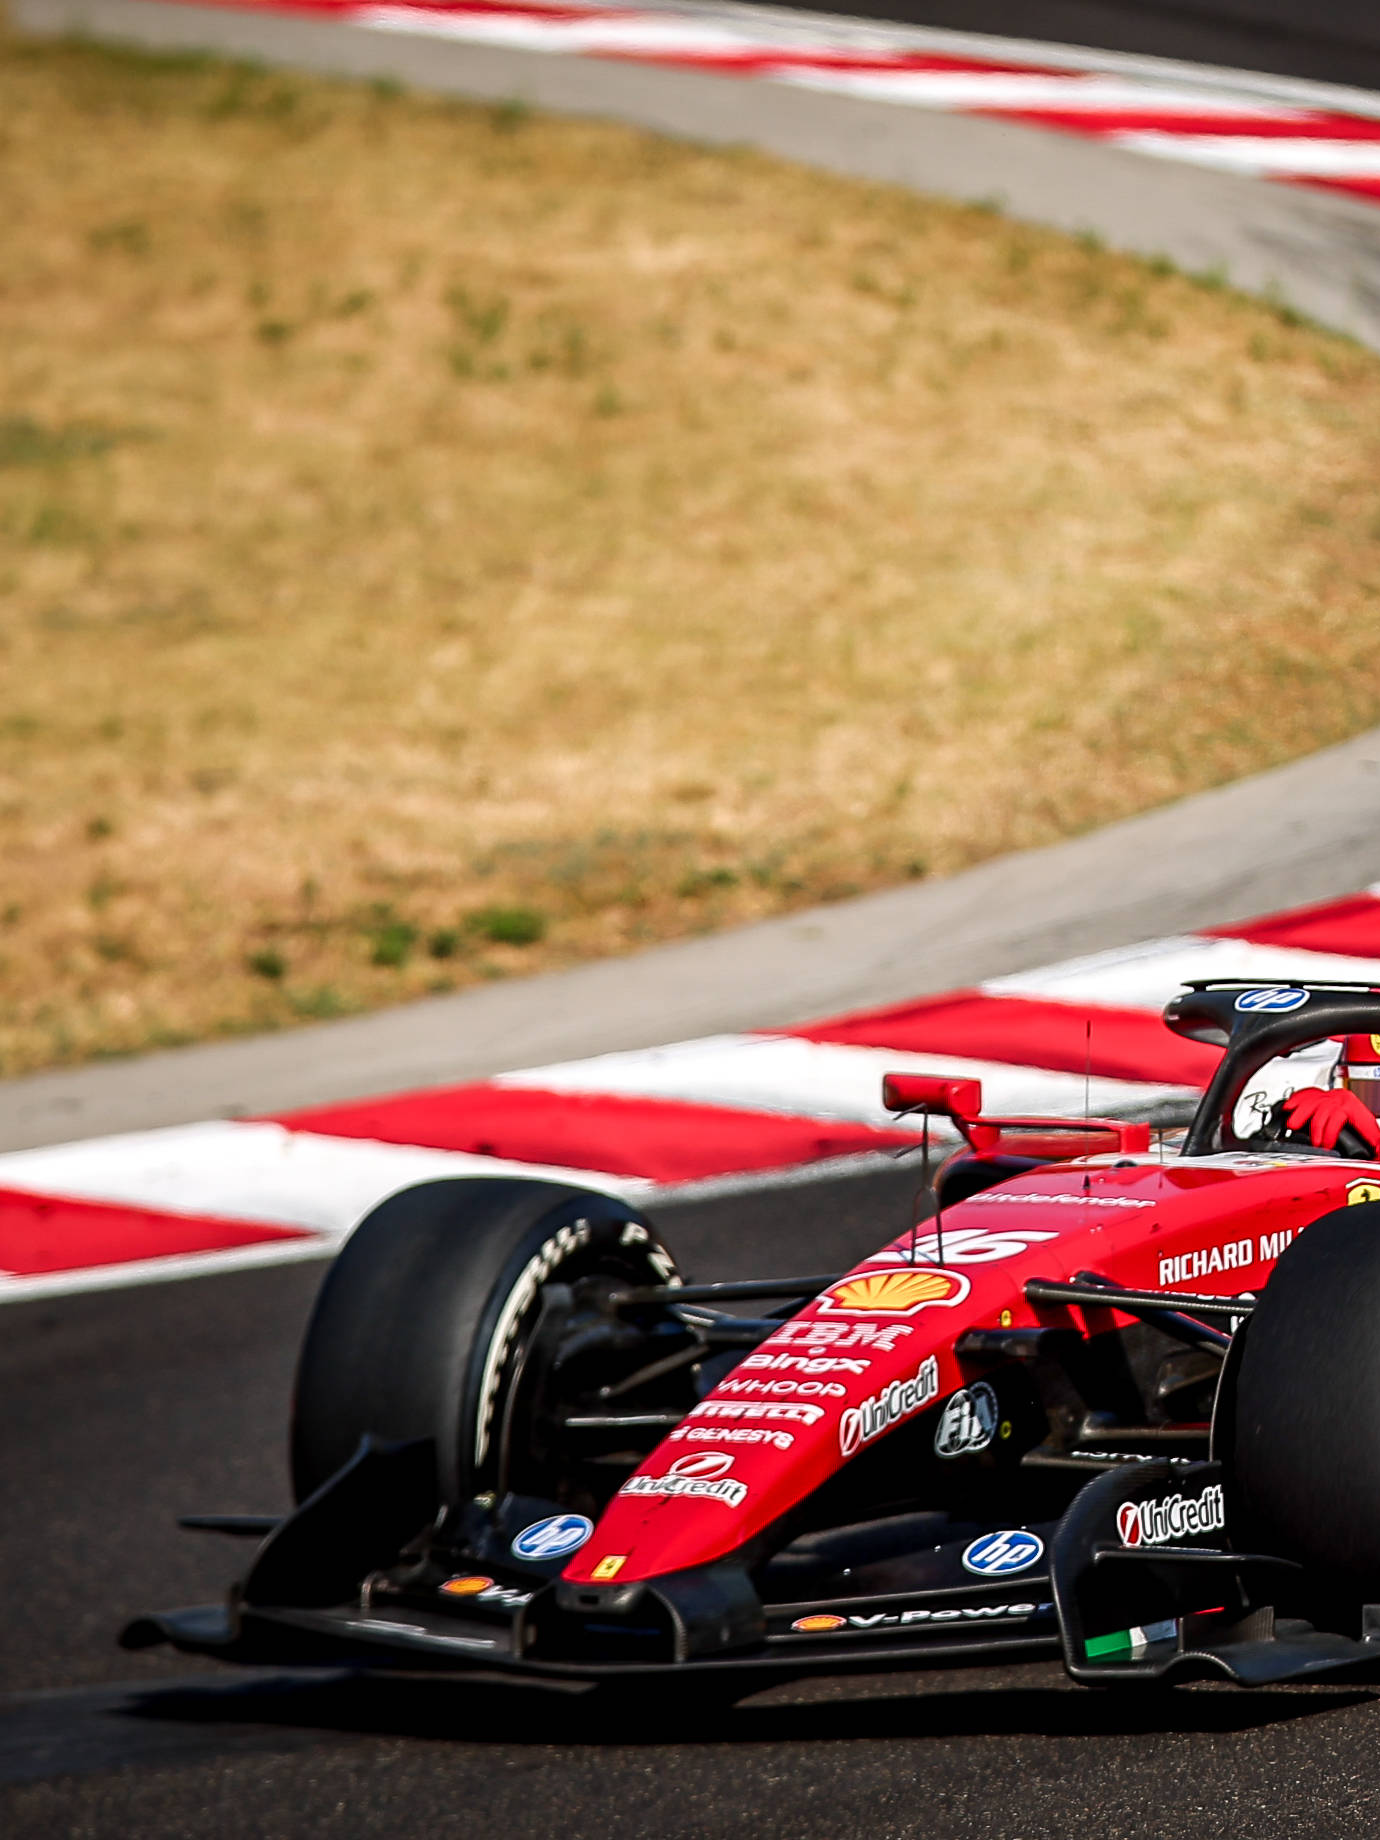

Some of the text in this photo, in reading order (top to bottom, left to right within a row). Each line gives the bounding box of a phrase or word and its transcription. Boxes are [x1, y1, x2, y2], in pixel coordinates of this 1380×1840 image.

[1239, 988, 1305, 1011] hp
[865, 1229, 1059, 1264] 16
[1158, 1239, 1253, 1286] RICHARD
[762, 1321, 914, 1351] IBM
[718, 1379, 846, 1397] WHOOP
[862, 1357, 937, 1440] UniCredit
[689, 1400, 825, 1425] PIRELLI
[687, 1427, 795, 1449] GENESYS
[620, 1475, 746, 1505] UniCredit
[1140, 1486, 1223, 1541] UniCredit
[519, 1515, 588, 1557] hp
[969, 1532, 1038, 1573] hp
